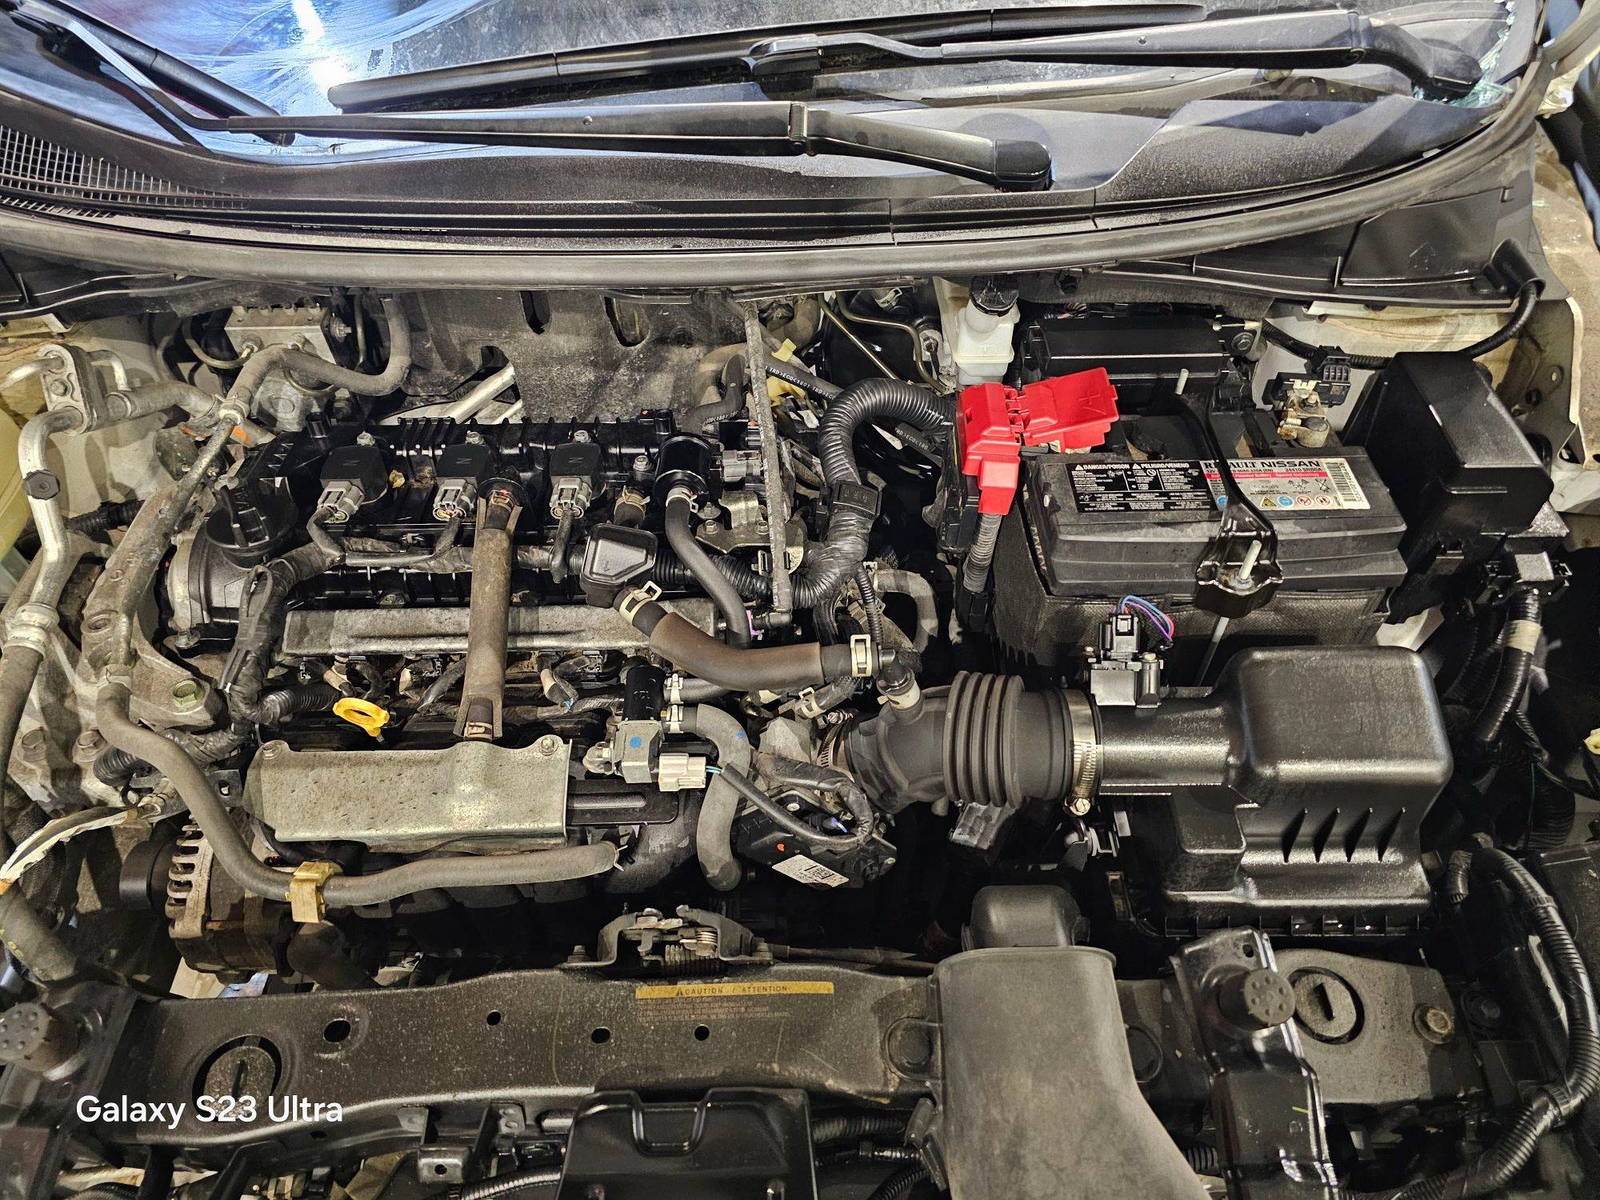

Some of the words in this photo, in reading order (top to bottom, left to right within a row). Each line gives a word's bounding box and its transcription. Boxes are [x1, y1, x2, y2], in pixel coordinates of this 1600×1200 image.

[1260, 460, 1321, 468] NISSAN
[684, 987, 723, 995] CAUTION
[741, 985, 788, 993] ATTENTION
